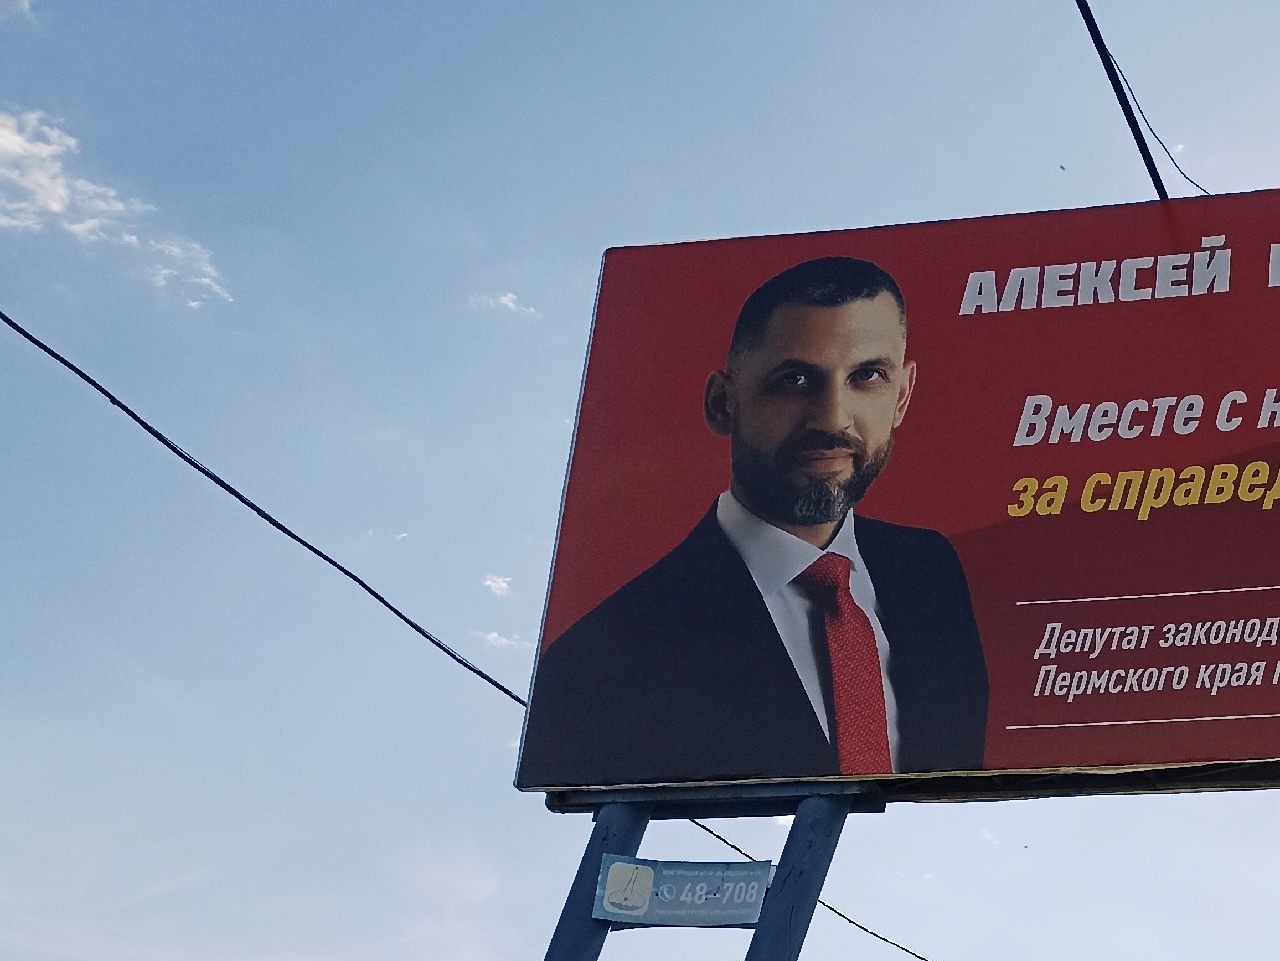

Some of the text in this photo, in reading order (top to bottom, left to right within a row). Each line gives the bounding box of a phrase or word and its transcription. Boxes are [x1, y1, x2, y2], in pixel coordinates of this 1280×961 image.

[959, 235, 1232, 316] АЛЕКСЕЙ
[1012, 394, 1205, 447] Вместе
[1215, 390, 1248, 432] с
[1007, 475, 1069, 517] за
[1033, 622, 1156, 660] Депутат
[1033, 664, 1190, 703] Пермского
[1195, 661, 1267, 696] края
[679, 881, 759, 905] 48-708
